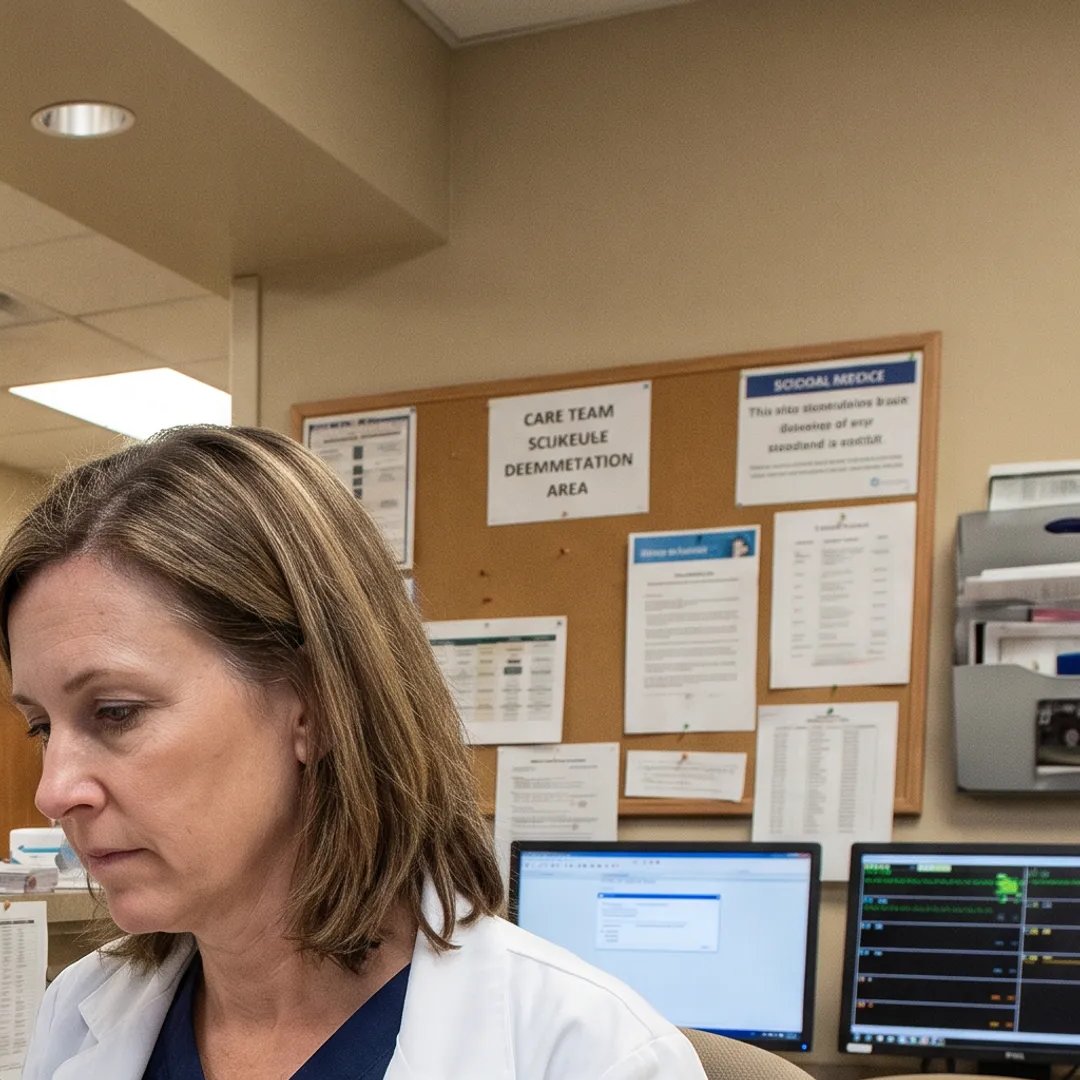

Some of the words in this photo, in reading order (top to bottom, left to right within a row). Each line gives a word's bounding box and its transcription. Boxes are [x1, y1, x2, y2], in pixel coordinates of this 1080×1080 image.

[523, 408, 565, 428] CARE
[568, 404, 615, 422] TEAM
[504, 452, 634, 478] DEEMMETATION
[546, 481, 589, 499] AREA
